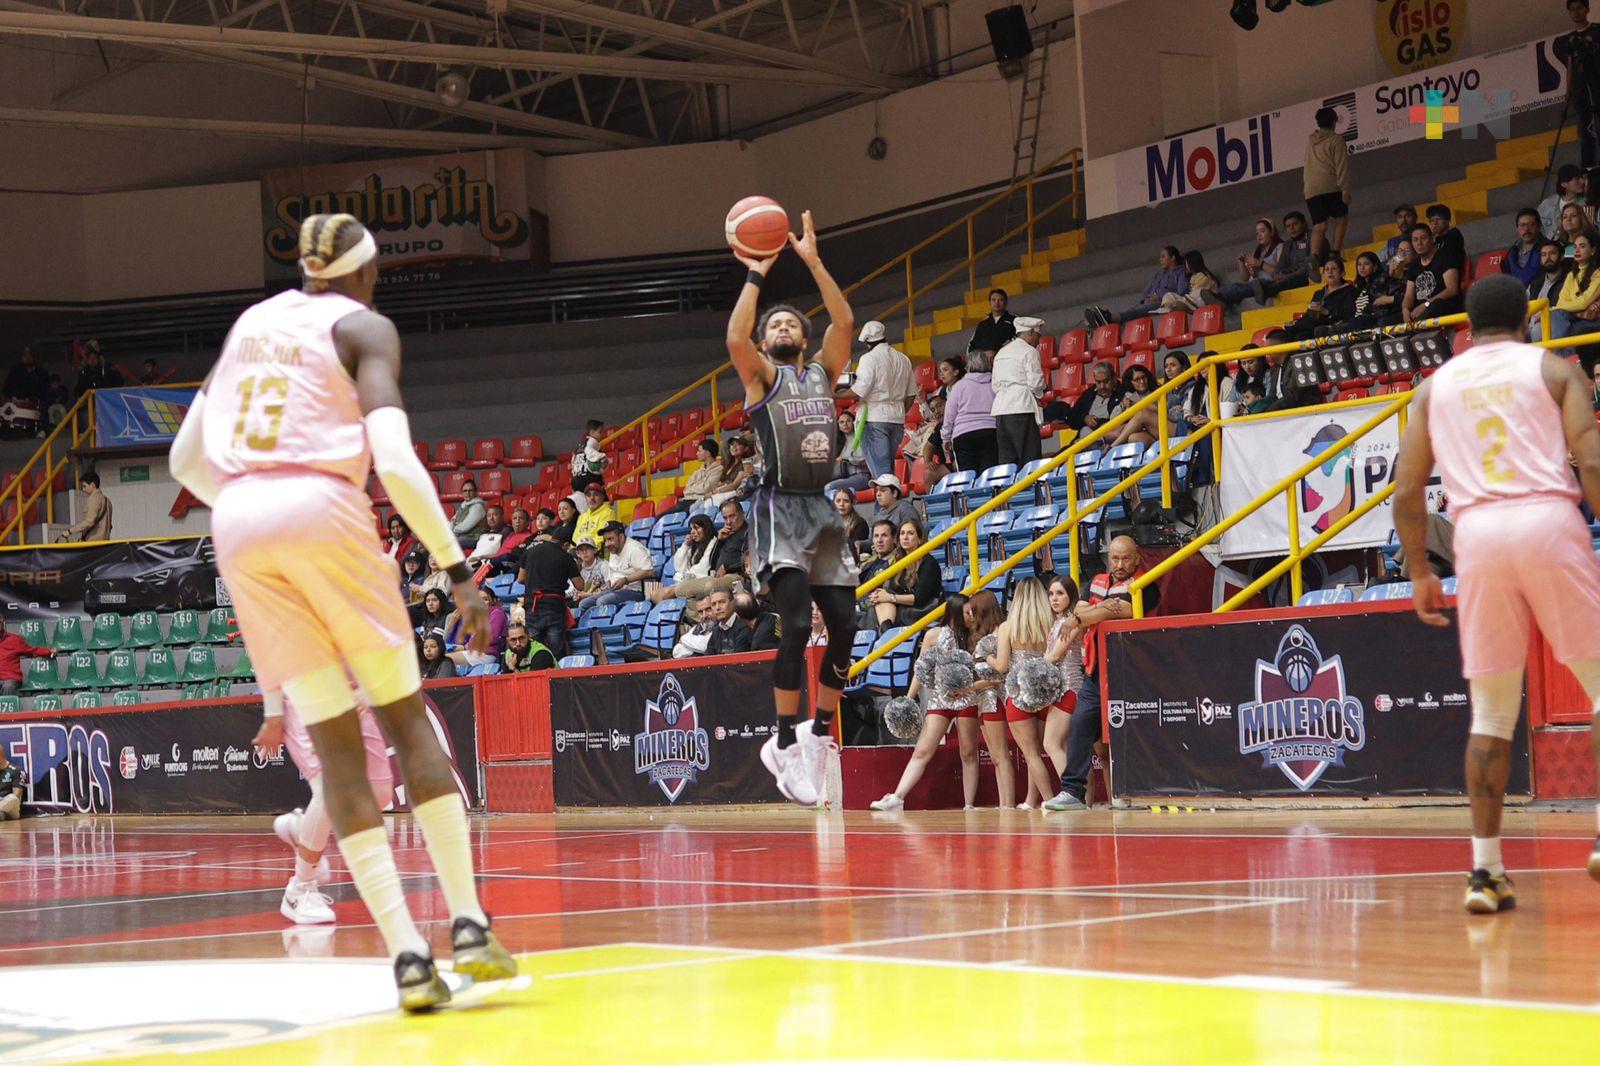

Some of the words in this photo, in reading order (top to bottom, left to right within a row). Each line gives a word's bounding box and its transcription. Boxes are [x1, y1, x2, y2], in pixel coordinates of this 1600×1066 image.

[1396, 25, 1453, 66] GAS
[1375, 68, 1482, 115] Santoyo
[1145, 115, 1274, 202] Mobil
[378, 239, 444, 256] RUPO
[231, 375, 289, 450] 13
[1366, 443, 1391, 452] 2024
[1476, 415, 1517, 483] 2
[62, 618, 75, 629] 57
[102, 615, 115, 626] 58
[139, 614, 152, 625] 59
[179, 612, 192, 623] 60
[27, 622, 39, 632] 56
[76, 656, 91, 668] 122
[114, 655, 129, 667] 123
[152, 652, 167, 664] 124
[192, 650, 207, 662] 125
[37, 660, 49, 672] 121
[1124, 701, 1159, 710] Zacatecas
[1215, 705, 1232, 716] PAZ
[1242, 698, 1364, 748] MINEROS
[192, 746, 219, 762] molten
[637, 729, 708, 768] MINEROS
[1270, 745, 1337, 759] ZACATECAS
[652, 765, 692, 778] ZACATECAS
